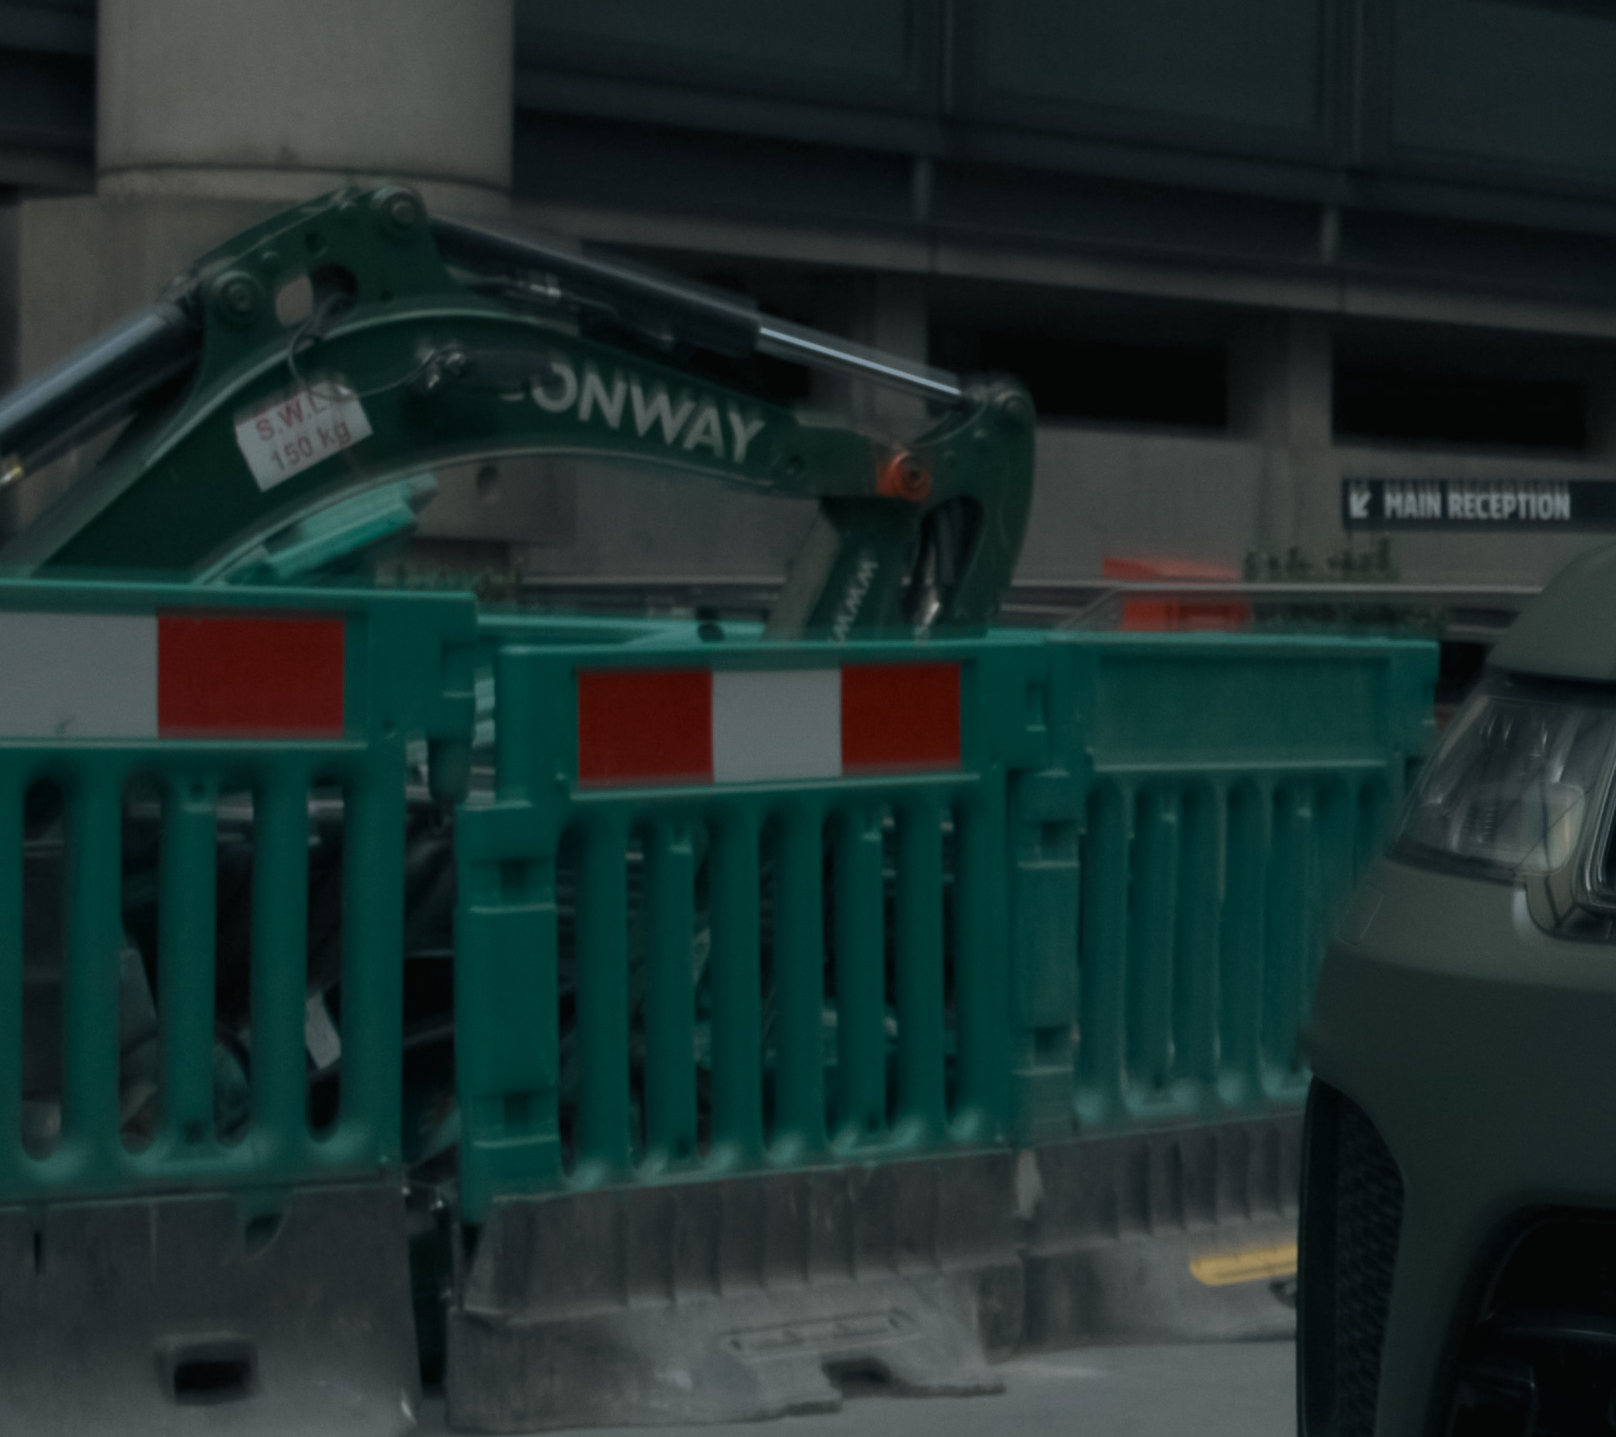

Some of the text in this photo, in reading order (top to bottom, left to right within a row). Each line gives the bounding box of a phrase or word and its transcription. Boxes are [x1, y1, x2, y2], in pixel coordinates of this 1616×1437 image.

[503, 364, 764, 461] ONWAY
[271, 420, 352, 471] 150 kg
[1384, 492, 1571, 520] MAIN RECEPTION
